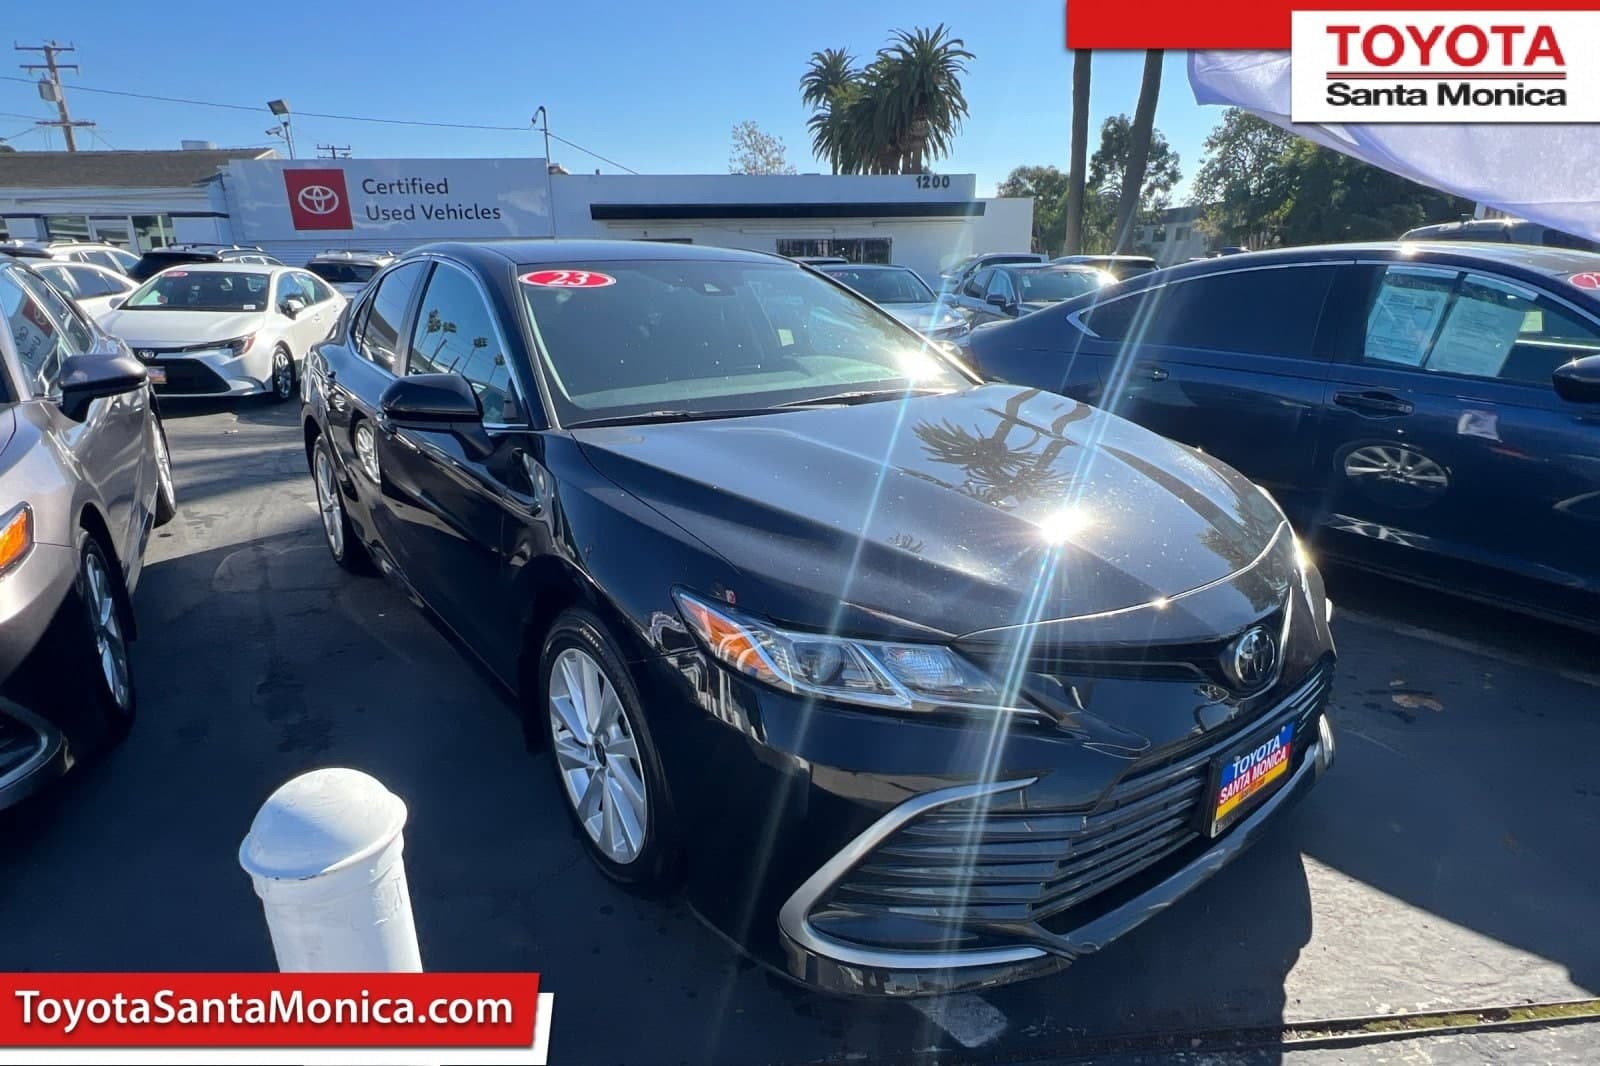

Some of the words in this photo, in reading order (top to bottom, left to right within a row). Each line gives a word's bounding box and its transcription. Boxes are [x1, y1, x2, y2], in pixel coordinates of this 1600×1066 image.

[362, 178, 449, 194] Certified
[916, 174, 950, 189] 1200
[366, 203, 416, 221] Used
[420, 203, 501, 220] Vehicles
[545, 271, 590, 286] 23
[1232, 735, 1280, 778] TOYOTA
[1220, 770, 1250, 804] SANTA
[1251, 746, 1286, 782] MONICA
